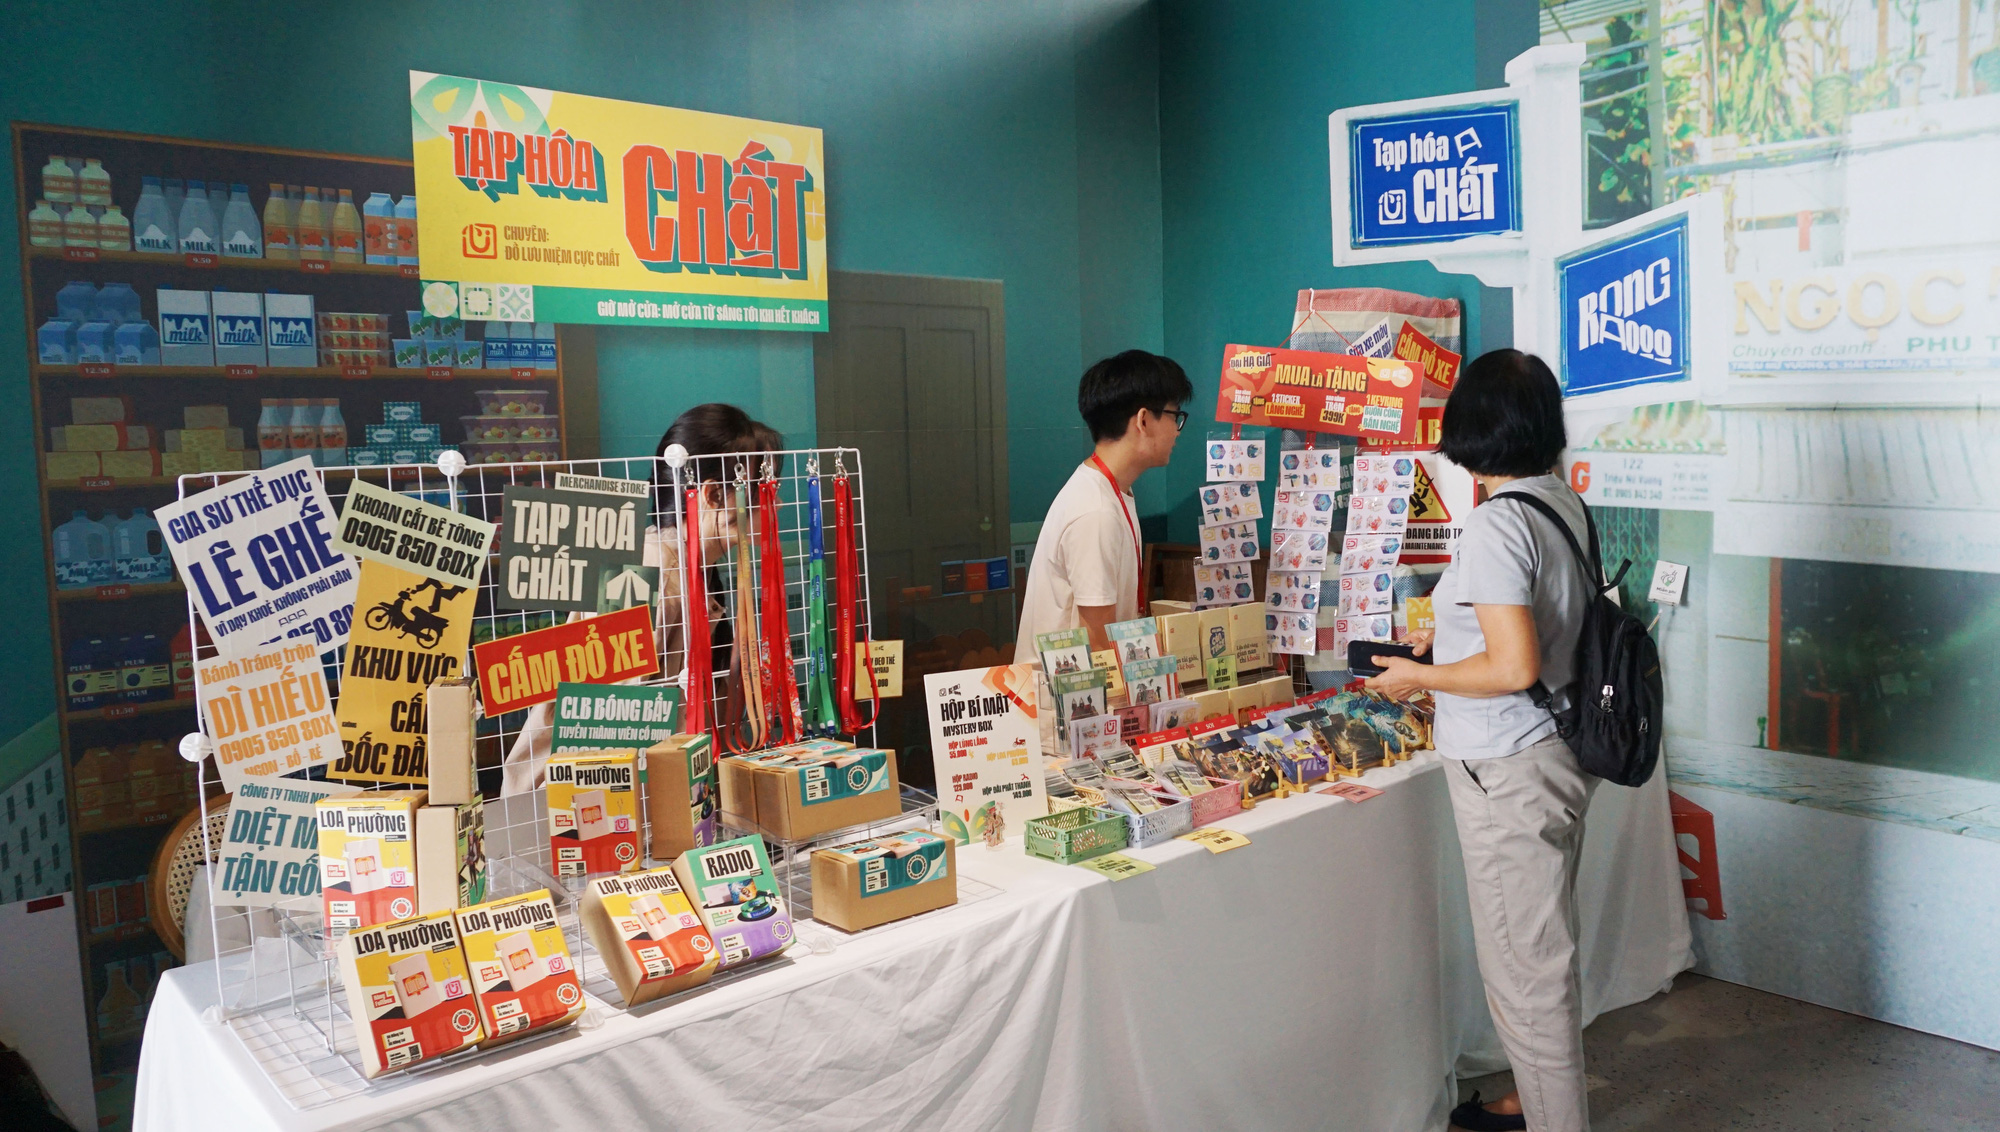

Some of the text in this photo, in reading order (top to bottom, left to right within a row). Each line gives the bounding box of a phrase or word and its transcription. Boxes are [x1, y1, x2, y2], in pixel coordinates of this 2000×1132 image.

[447, 124, 599, 192] TẠP HÓA
[1373, 131, 1450, 173] Tạp hóa
[140, 238, 172, 249] MILK
[185, 240, 216, 252] MILK
[504, 225, 550, 242] CHUYÊN:
[228, 243, 258, 255] MILK
[505, 242, 620, 267] ĐỒ LƯU NIỆM CỰC CHẤT
[598, 300, 616, 317] GIỜ
[618, 301, 636, 318] MỞ
[637, 301, 660, 318] CỬA:
[663, 301, 680, 319] MỞ
[681, 302, 701, 320] CỬA
[702, 303, 715, 320] TỪ
[717, 304, 742, 322] SÁNG
[760, 308, 774, 323] KHI
[775, 305, 791, 324] HẾT
[792, 307, 820, 325] KHÁCH
[1734, 270, 1966, 343] NGỌC
[169, 328, 203, 342] milk
[224, 329, 256, 343] milk
[276, 330, 307, 344] milk
[1373, 323, 1388, 344] máy
[1243, 356, 1254, 369] HẠ
[1397, 332, 1418, 362] CẤM
[1433, 358, 1453, 384] XE
[1275, 364, 1311, 385] MUA
[1326, 365, 1368, 394] TẶNG
[1276, 394, 1300, 405] STICKER
[1371, 394, 1404, 409] KEYRING
[1322, 410, 1344, 423] 399K
[560, 475, 646, 495] MERCHANDISE STORE
[168, 469, 312, 544] GIA SƯ THỂ DỤC
[352, 493, 402, 524] KHOAN
[427, 517, 446, 538] BÊ
[446, 523, 485, 550] TÔNG
[512, 500, 635, 553] TẠP HOÁ
[1406, 526, 1451, 539] ĐANG BẢO
[188, 496, 345, 617] LÊ GHẾ
[342, 517, 480, 580] 0905 850 80X
[1405, 542, 1447, 550] MAINTENANCE
[508, 545, 588, 602] CHẤT
[215, 620, 229, 637] VÌ
[228, 615, 248, 631] DẠY
[275, 587, 309, 612] KHÔNG
[331, 568, 353, 587] BÀN
[70, 664, 91, 672] PLUM
[201, 660, 240, 686] Bánh
[240, 653, 282, 675] Tráng
[283, 644, 316, 663] trộn
[350, 645, 403, 681] KHU
[487, 624, 648, 705] CẤM ĐỔ XE
[248, 665, 326, 729] HIẾU
[560, 696, 592, 720] CLB
[593, 693, 641, 722] BÓNG
[940, 693, 1009, 723] HỘP BÍ MẬT
[390, 692, 428, 735] CẤ
[219, 714, 335, 765] 0905 850 80X
[558, 721, 587, 739] TUYỂN
[588, 725, 617, 740] THÀNH
[618, 726, 638, 740] VIÊN
[943, 720, 993, 737] MYSTERY BOX
[335, 731, 428, 777] BỐC ĐẦ
[948, 740, 958, 751] HỘP
[550, 765, 631, 786] LOA PHƯỜNG
[240, 783, 309, 804] CÔNG TY TNHH
[229, 806, 292, 851] DIỆT
[320, 810, 406, 834] LOA PHƯỜNG
[222, 852, 322, 899] TẬN GỐ
[706, 849, 754, 879] RADIO
[597, 873, 675, 895] LOA PHƯỜNG
[462, 902, 553, 933] LOA PHƯỜNG
[355, 921, 454, 955] LOA PHƯỜNG
